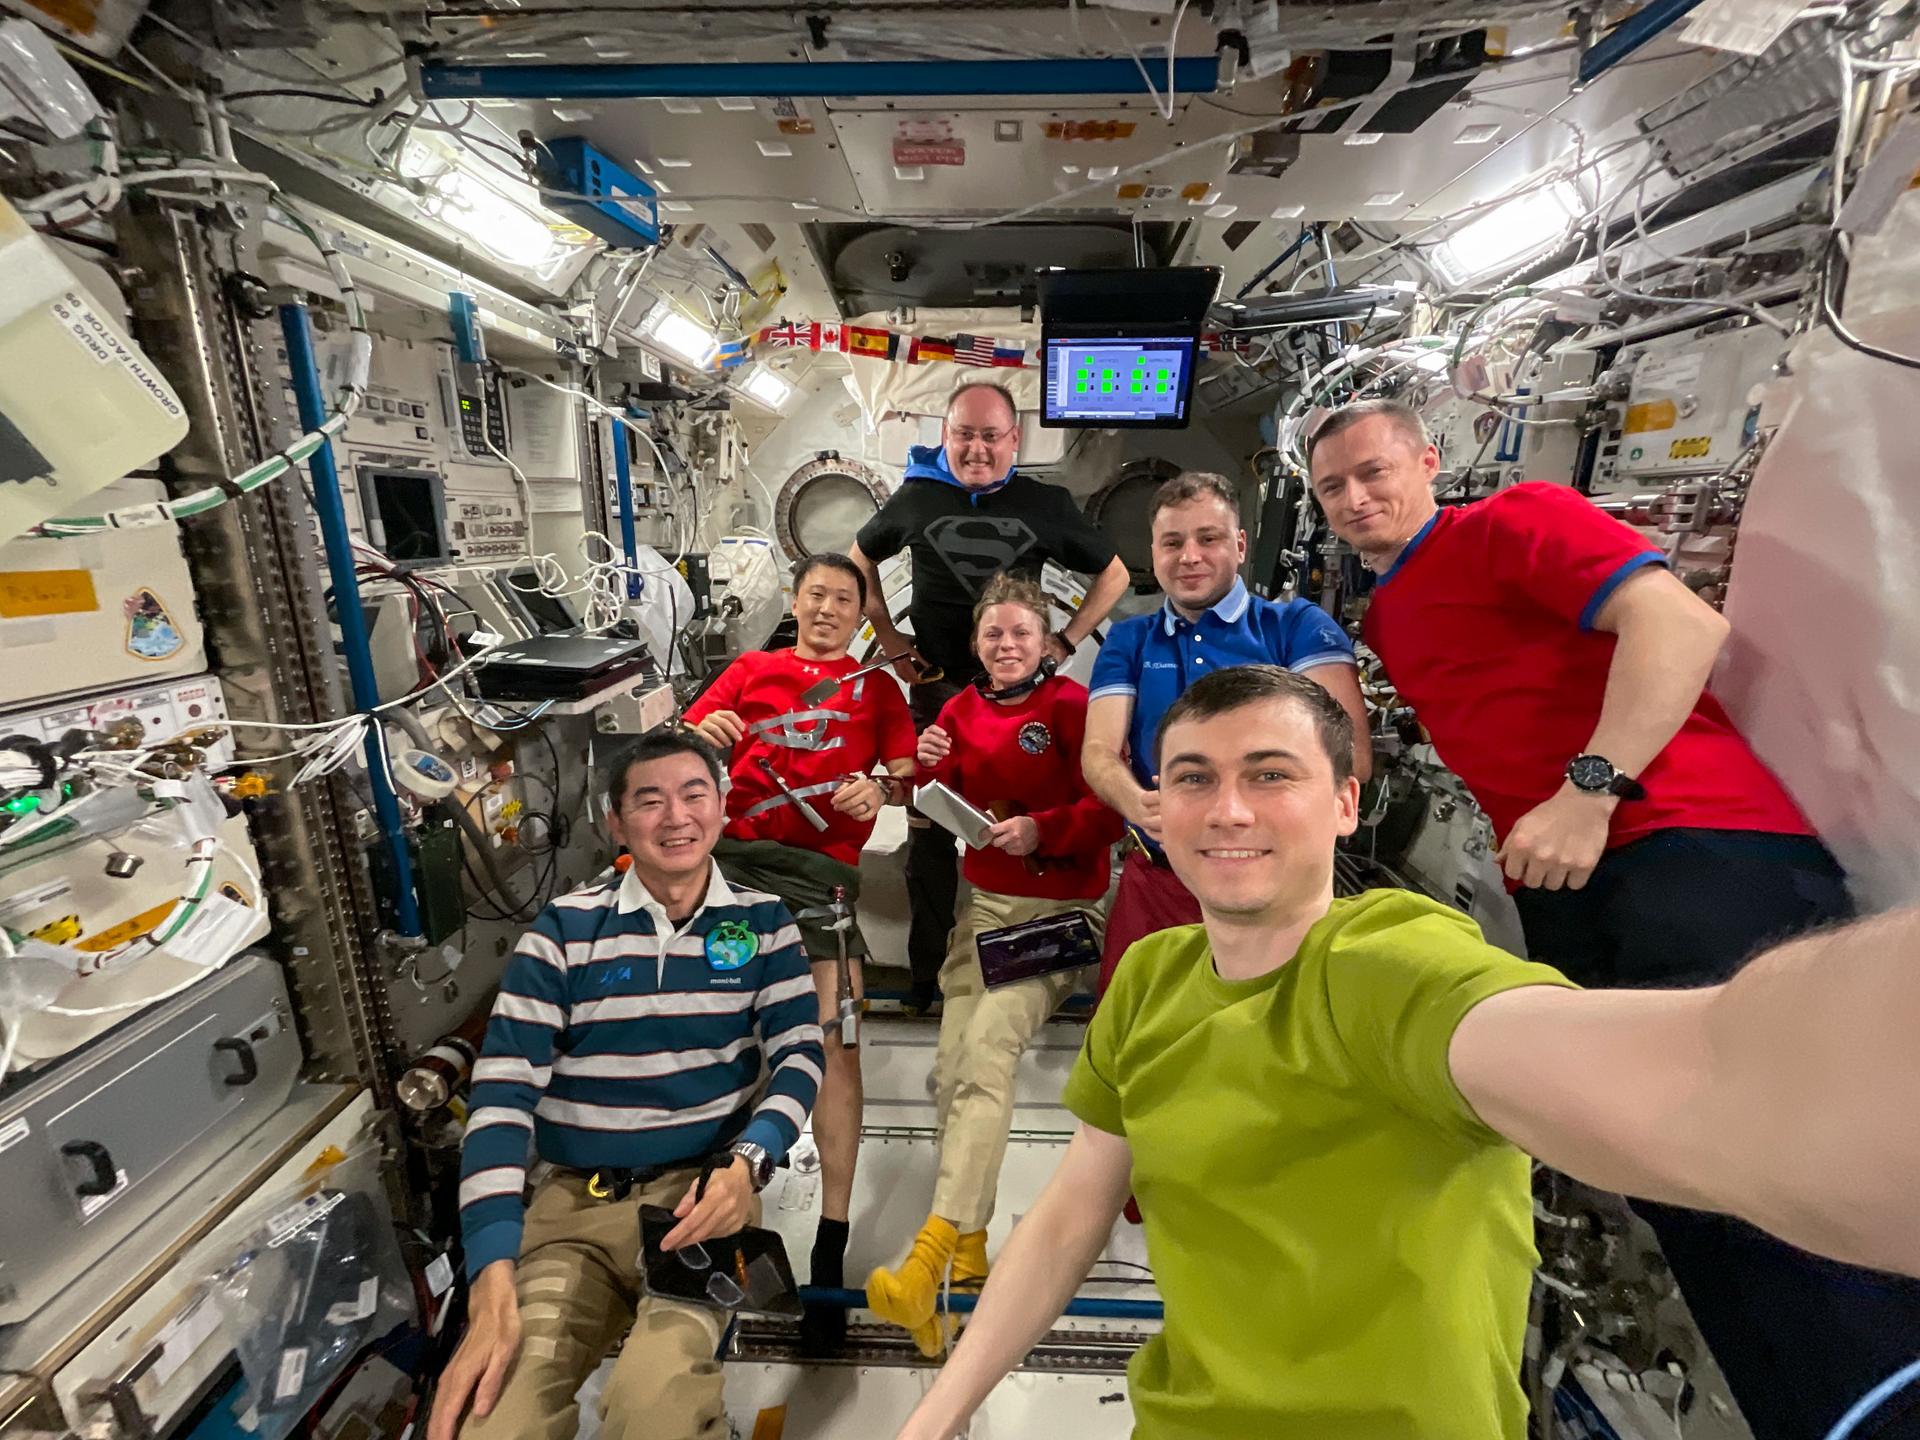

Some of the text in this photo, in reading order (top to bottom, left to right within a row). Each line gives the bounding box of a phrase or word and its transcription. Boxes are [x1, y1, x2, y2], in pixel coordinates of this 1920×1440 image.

[73, 324, 108, 360] DRUG
[84, 312, 131, 361] FACTOR
[130, 363, 179, 415] GROWTH
